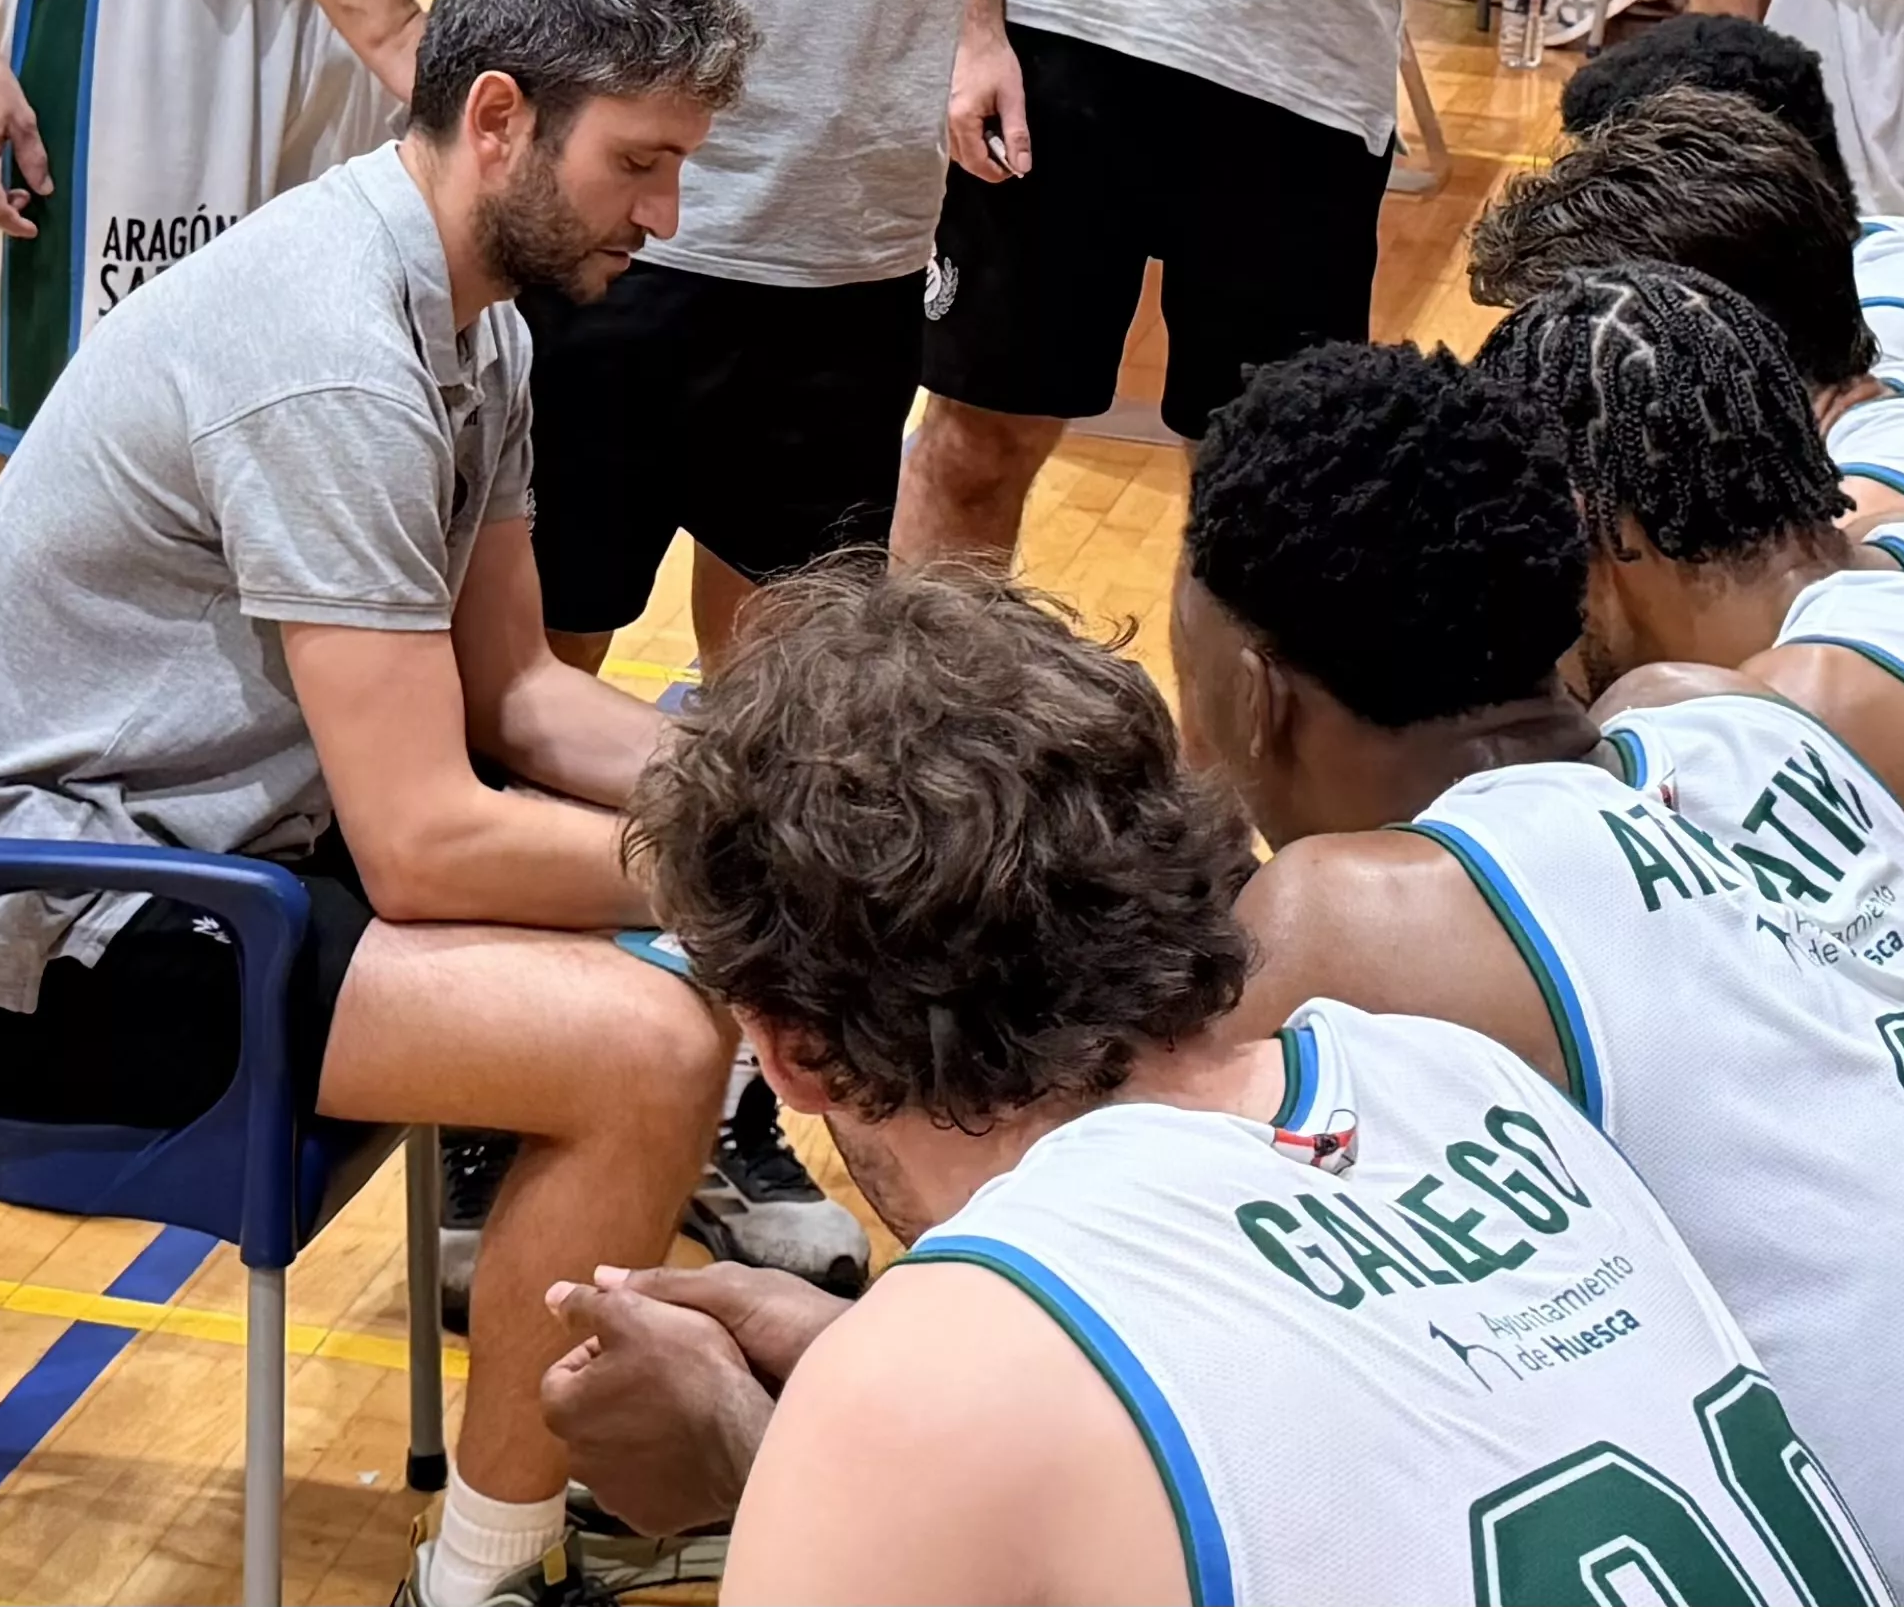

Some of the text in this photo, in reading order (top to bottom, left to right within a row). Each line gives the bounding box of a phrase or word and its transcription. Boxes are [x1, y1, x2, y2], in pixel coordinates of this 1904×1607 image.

[1476, 1252, 1635, 1340] Ayuntamiento
[1516, 1306, 1642, 1373] de Huesca
